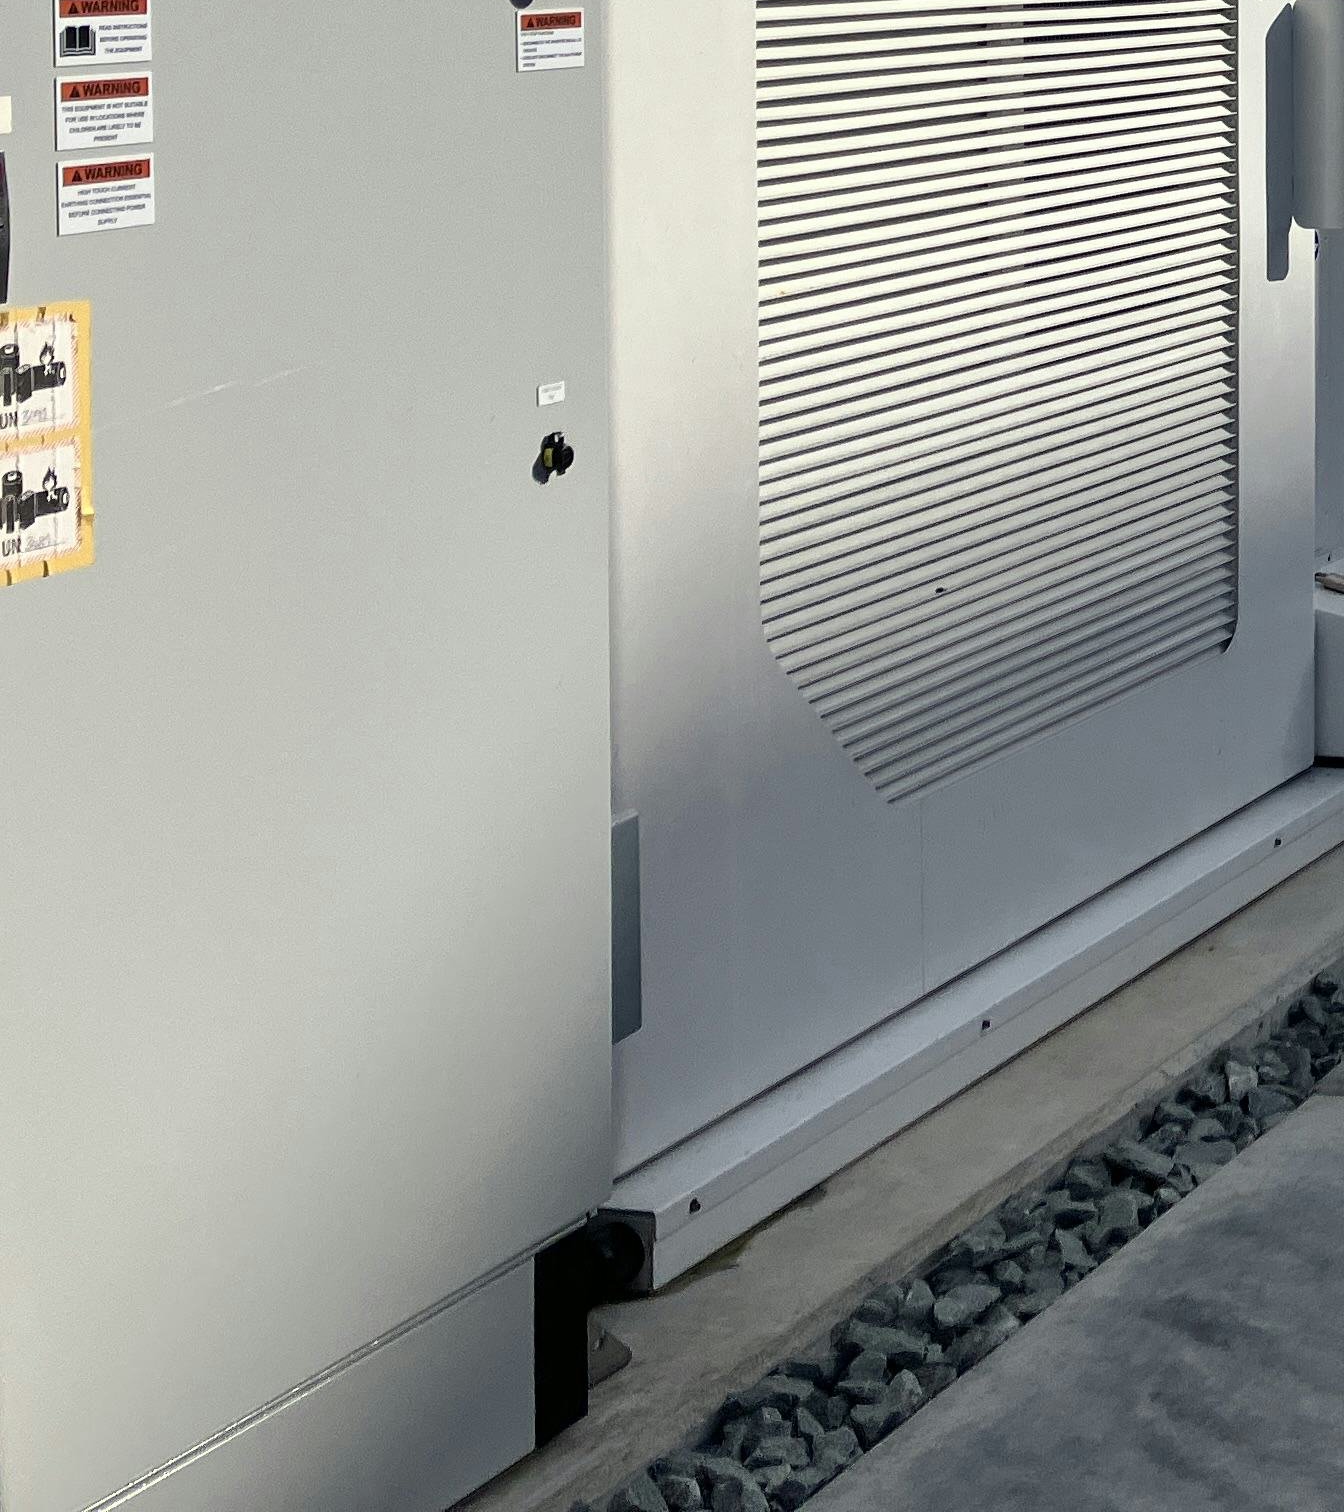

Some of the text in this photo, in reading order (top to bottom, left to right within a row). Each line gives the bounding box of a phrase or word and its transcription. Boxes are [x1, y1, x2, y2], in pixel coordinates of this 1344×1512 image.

[81, 0, 139, 13] WARNING
[536, 15, 576, 27] WARNING
[82, 82, 140, 96] WARNING
[84, 164, 142, 180] WARNING
[0, 411, 18, 429] UN
[2, 535, 21, 556] UN
